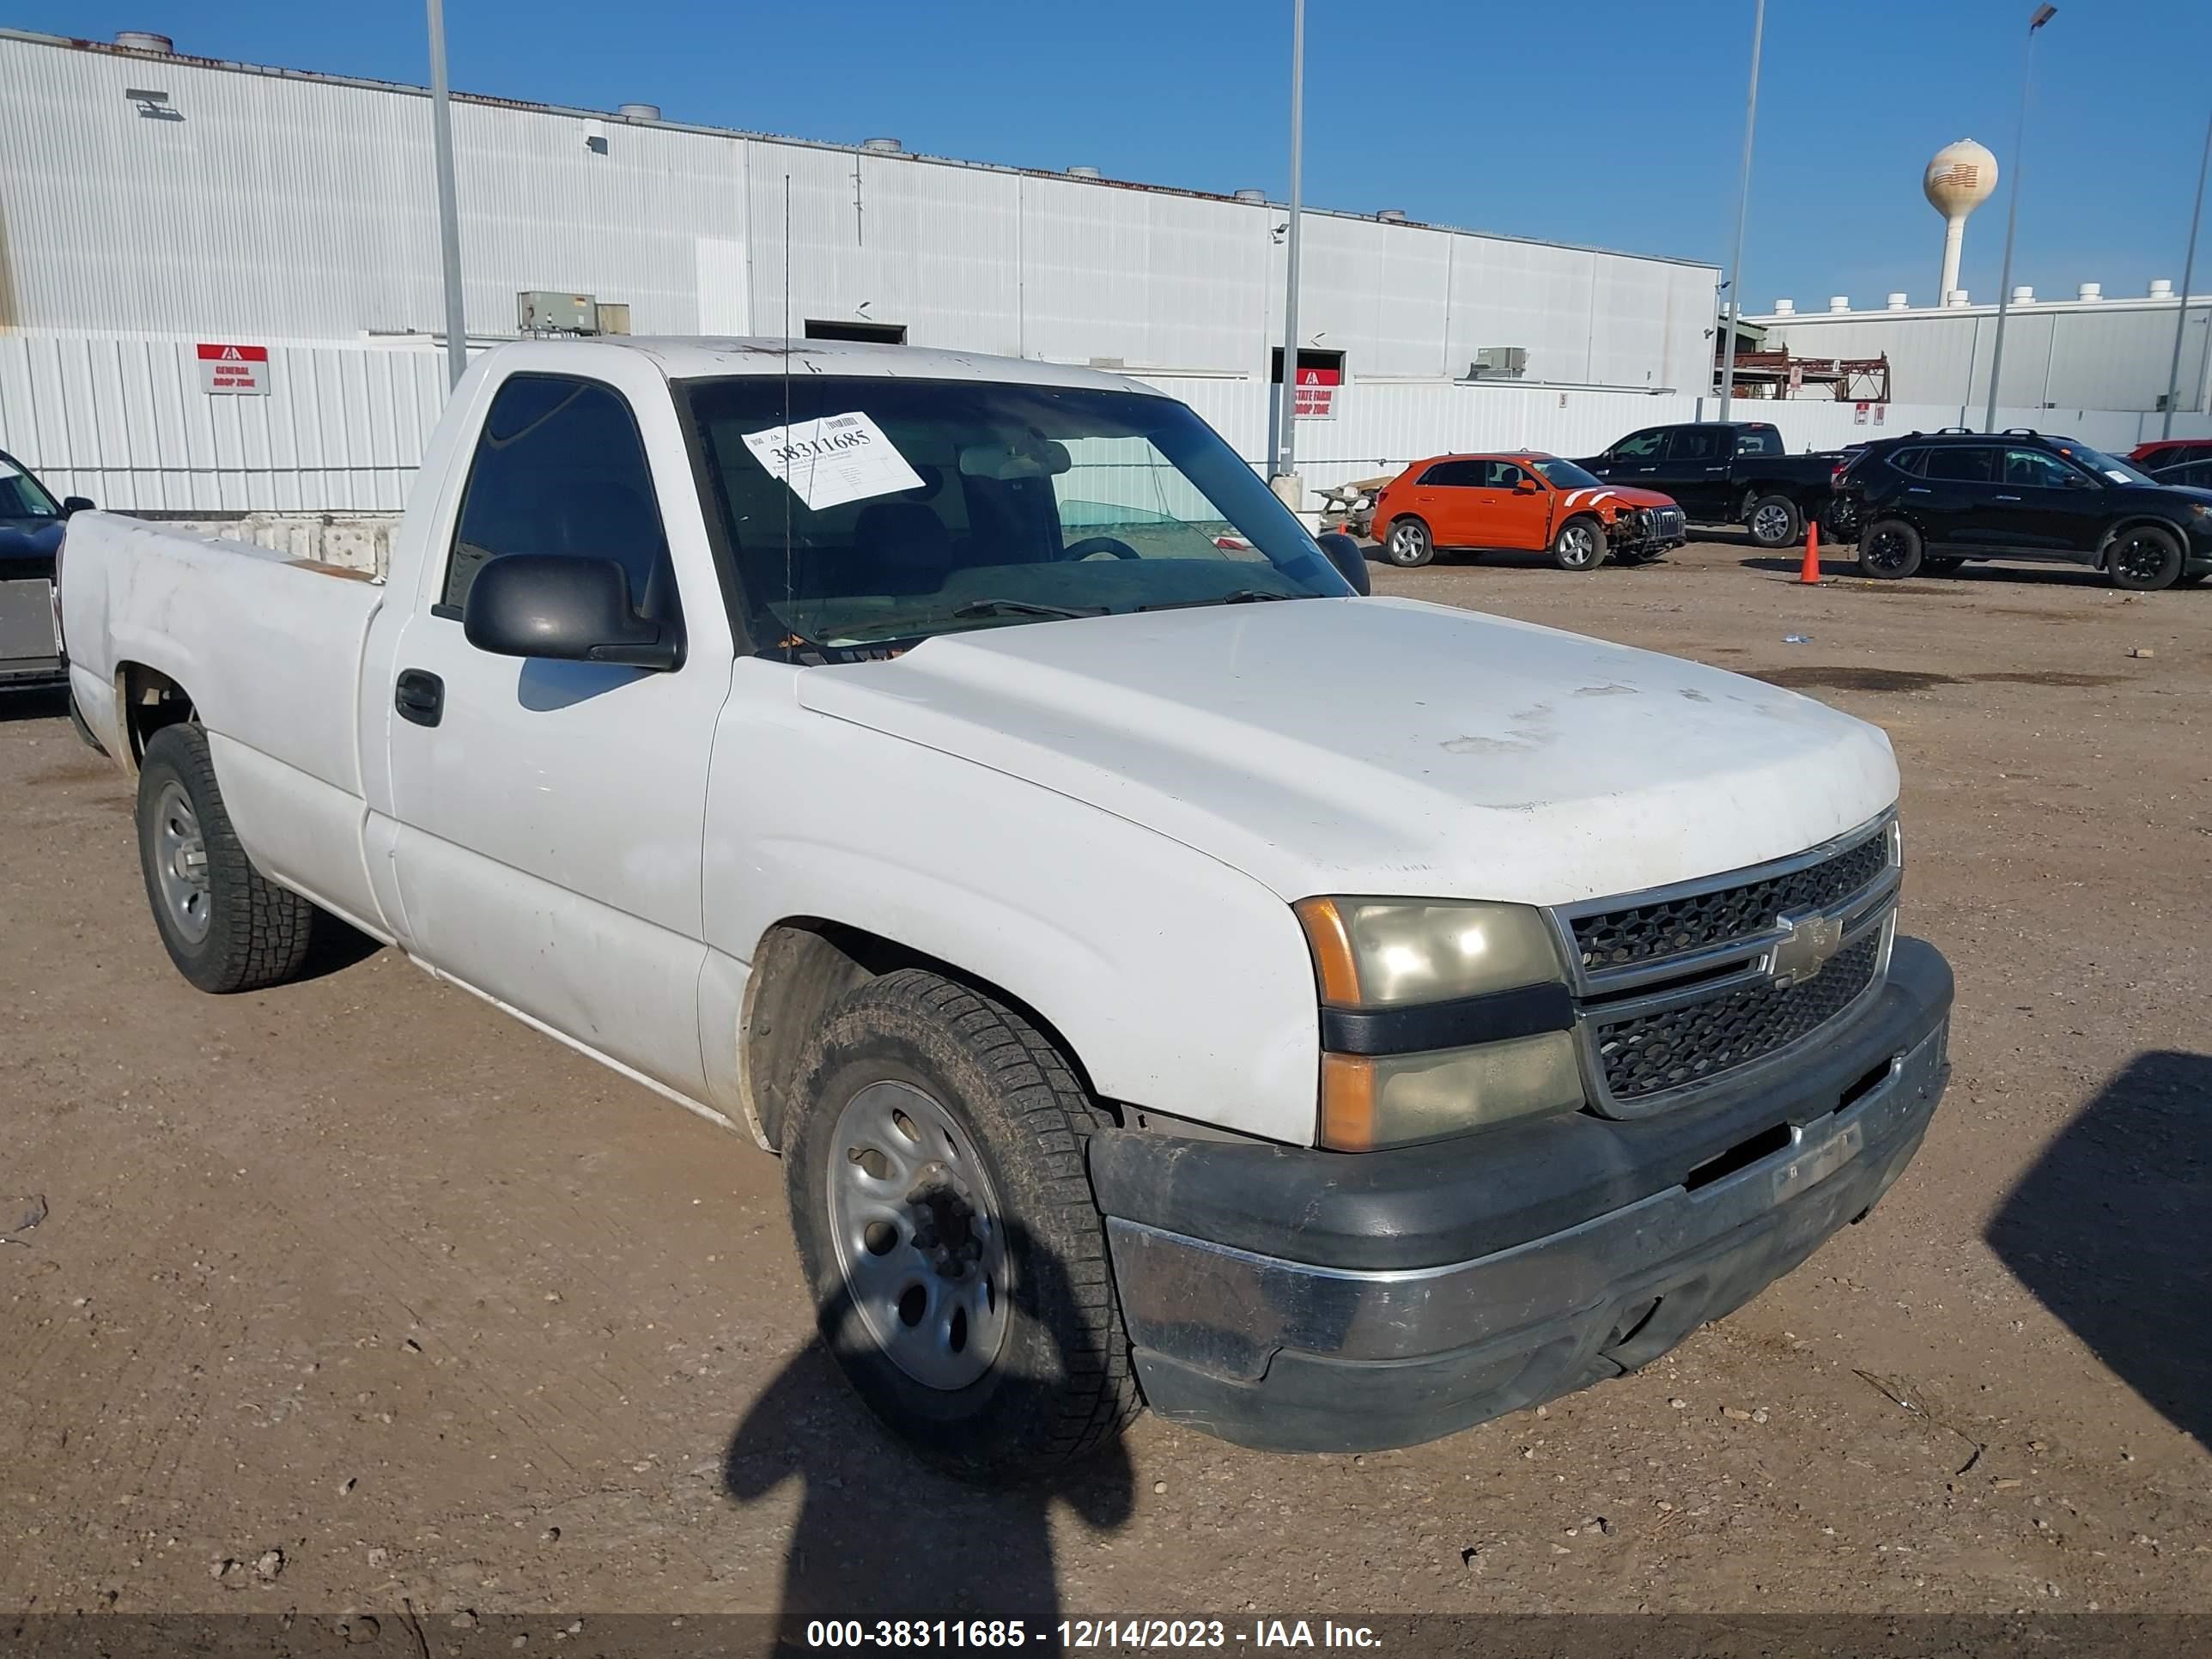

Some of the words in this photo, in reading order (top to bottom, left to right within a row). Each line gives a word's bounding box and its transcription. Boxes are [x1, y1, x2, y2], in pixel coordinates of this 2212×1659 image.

[216, 366, 249, 375] GENERAL
[213, 378, 234, 386] DROP
[236, 379, 255, 387] ZONE
[1314, 390, 1332, 401] FARM
[1313, 404, 1329, 415] ZONE
[769, 429, 872, 464] 38311685
